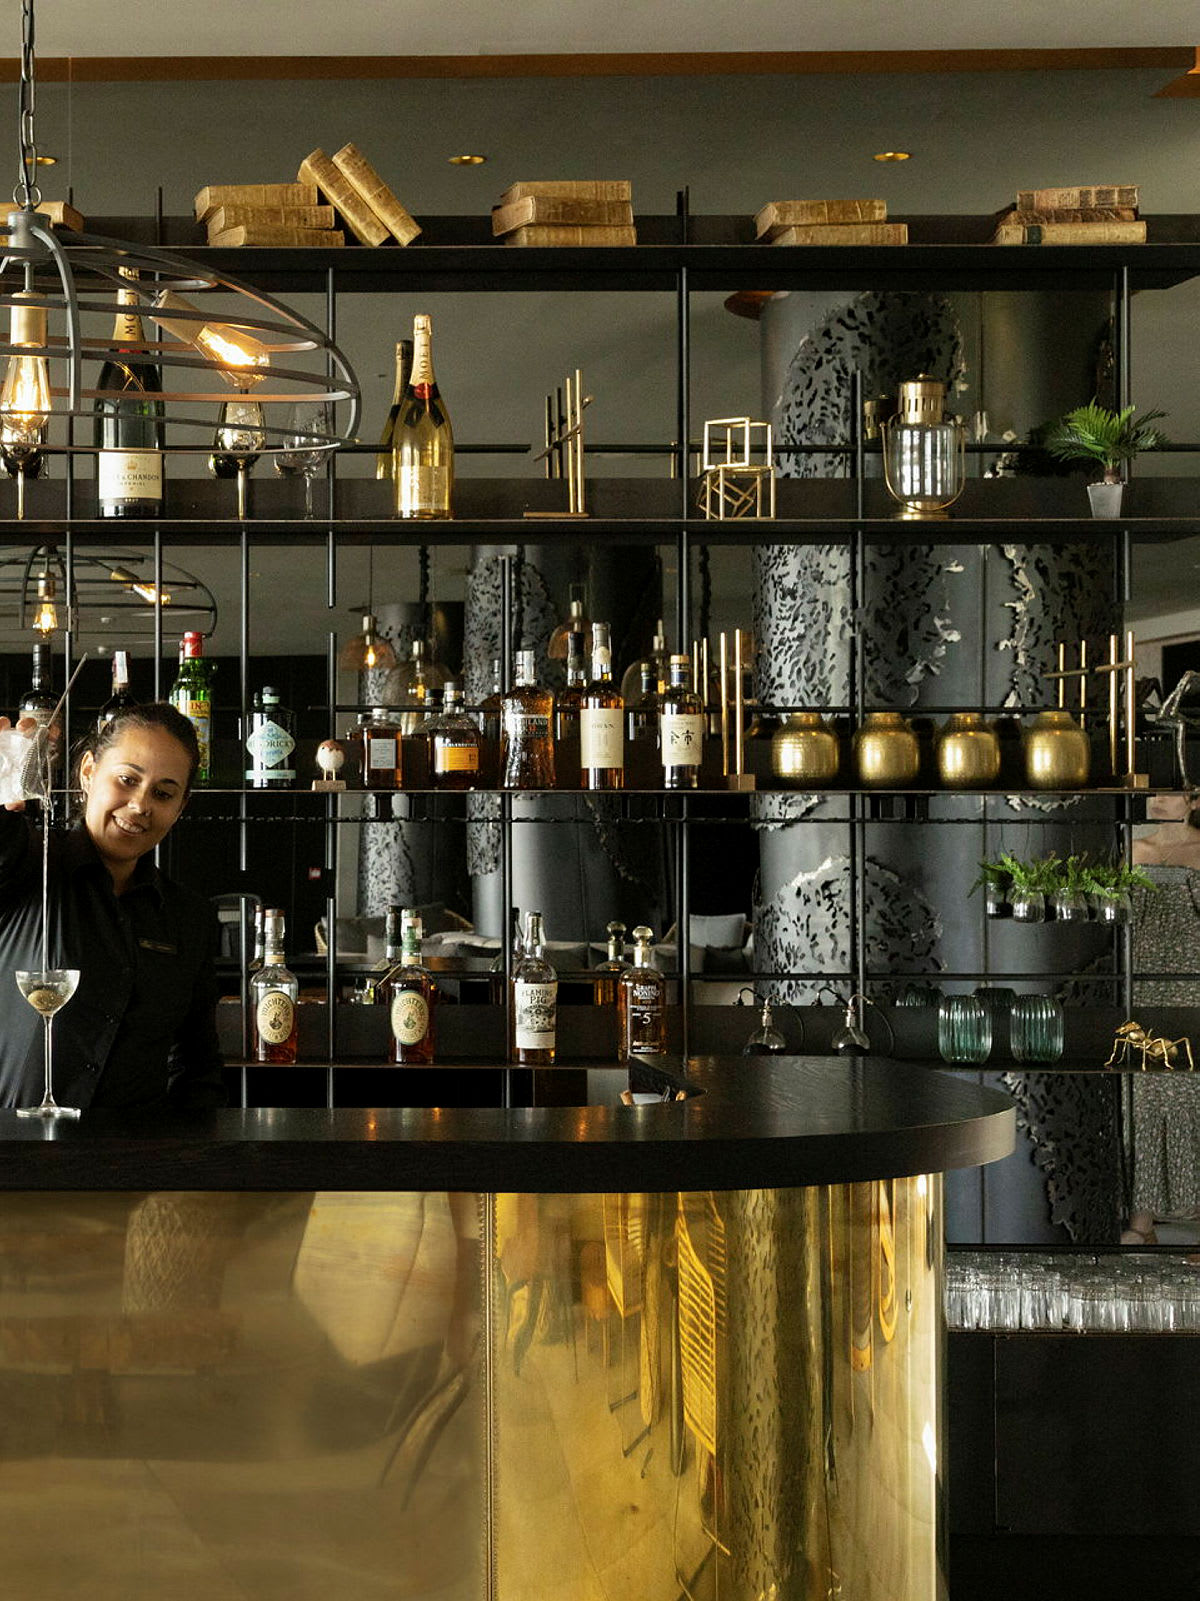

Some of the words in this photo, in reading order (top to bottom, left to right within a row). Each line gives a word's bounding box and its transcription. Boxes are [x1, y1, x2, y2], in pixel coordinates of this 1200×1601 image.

[127, 473, 160, 481] CHANDON
[530, 996, 547, 1004] PIG
[642, 1012, 652, 1025] 5
